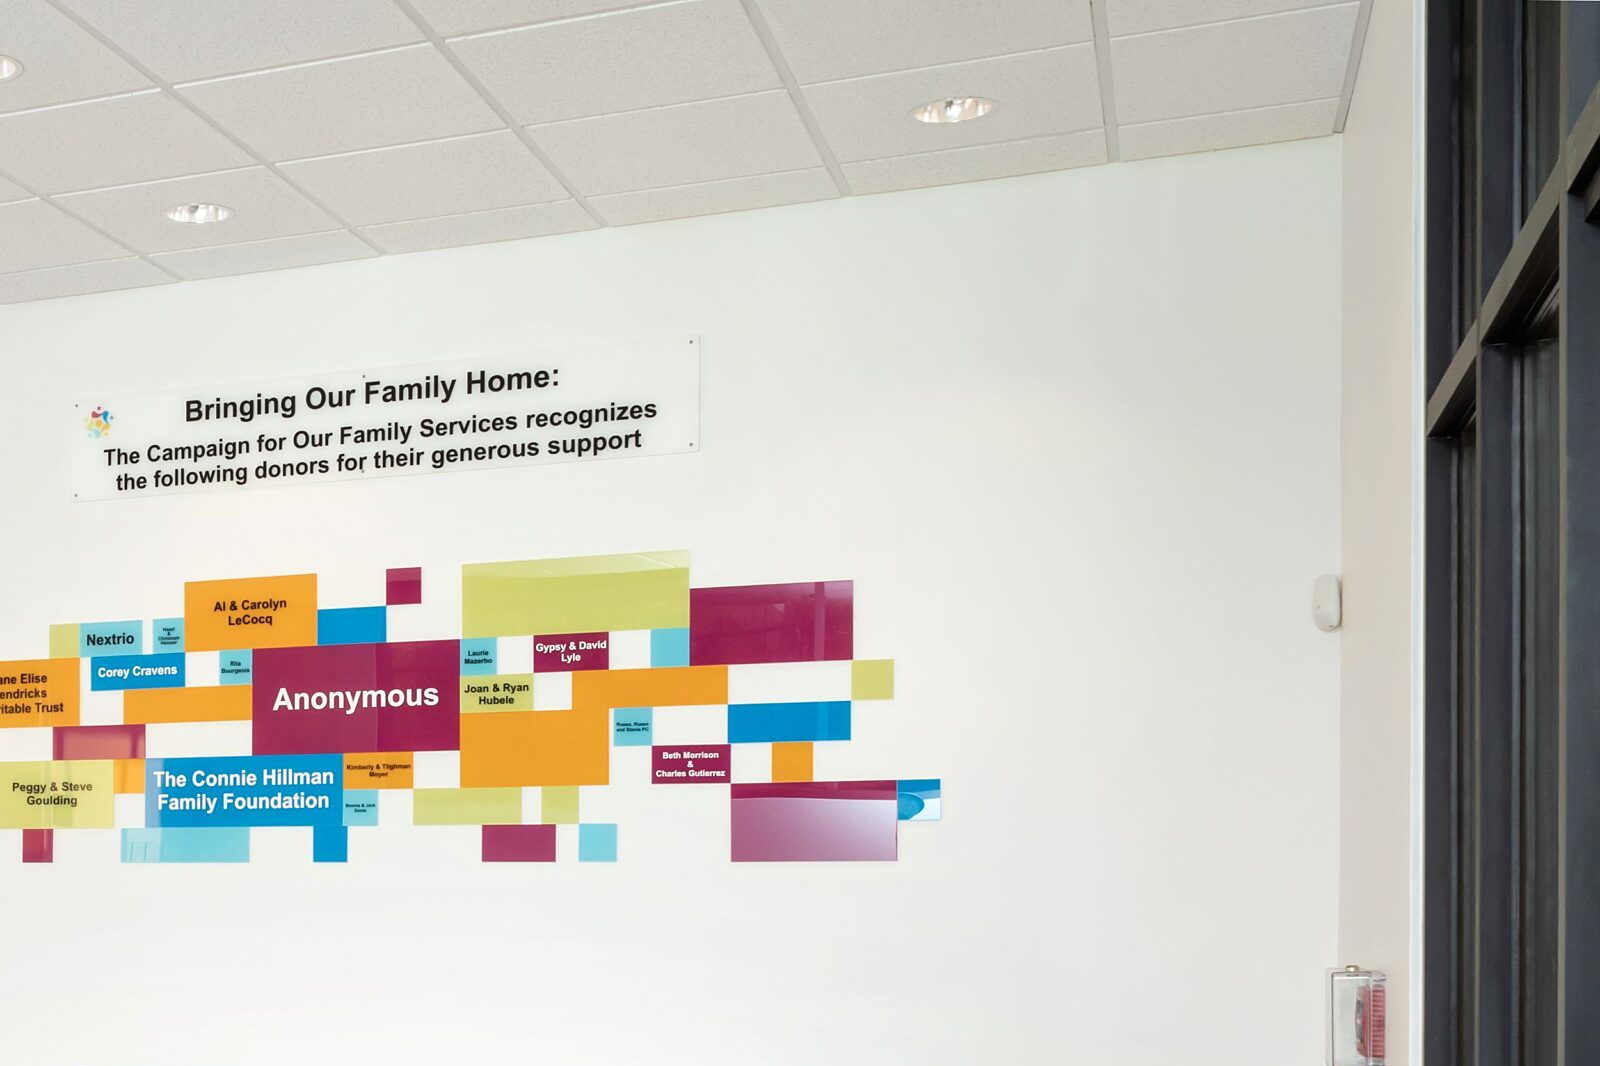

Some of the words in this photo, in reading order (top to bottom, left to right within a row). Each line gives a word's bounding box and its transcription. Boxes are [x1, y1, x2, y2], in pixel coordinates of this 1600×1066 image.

[186, 394, 295, 422] Bringing
[306, 387, 355, 409] Our
[366, 375, 456, 404] Family
[467, 365, 558, 394] Home:
[104, 448, 140, 466] The
[147, 439, 249, 462] Campaign
[257, 434, 286, 452] for
[294, 431, 333, 448] Our
[341, 422, 412, 449] Family
[420, 415, 517, 437] Services
[527, 402, 656, 428] recognizes
[116, 473, 147, 490] the
[154, 466, 247, 490] following
[255, 458, 329, 479] donors
[337, 450, 367, 471] for
[374, 448, 424, 468] their
[432, 442, 539, 468] generous
[548, 430, 641, 457] support
[214, 602, 225, 611] Al
[230, 601, 237, 611] &
[242, 599, 286, 611] Carolyn
[228, 613, 273, 627] LeCocq
[87, 633, 134, 646] Nextrio
[536, 643, 566, 653] Gypsy
[569, 642, 576, 650] &
[579, 640, 606, 649] David
[561, 653, 581, 663] Lyle
[21, 673, 47, 684] Elise
[98, 668, 129, 679] Corey
[133, 666, 177, 676] Cravens
[465, 685, 489, 693] Joan
[493, 684, 500, 692] &
[503, 683, 529, 694] Ryan
[273, 688, 439, 714] Anonymous
[479, 696, 514, 704] Hubele
[35, 702, 64, 713] Trust
[687, 760, 694, 768] &
[153, 771, 186, 787] The
[193, 770, 257, 786] Connie
[263, 769, 333, 785] Hillman
[13, 783, 46, 794] Peggy
[47, 782, 58, 791] &
[62, 782, 92, 791] Steve
[27, 796, 77, 807] Goulding
[158, 794, 217, 813] Family
[224, 792, 329, 809] Foundation
